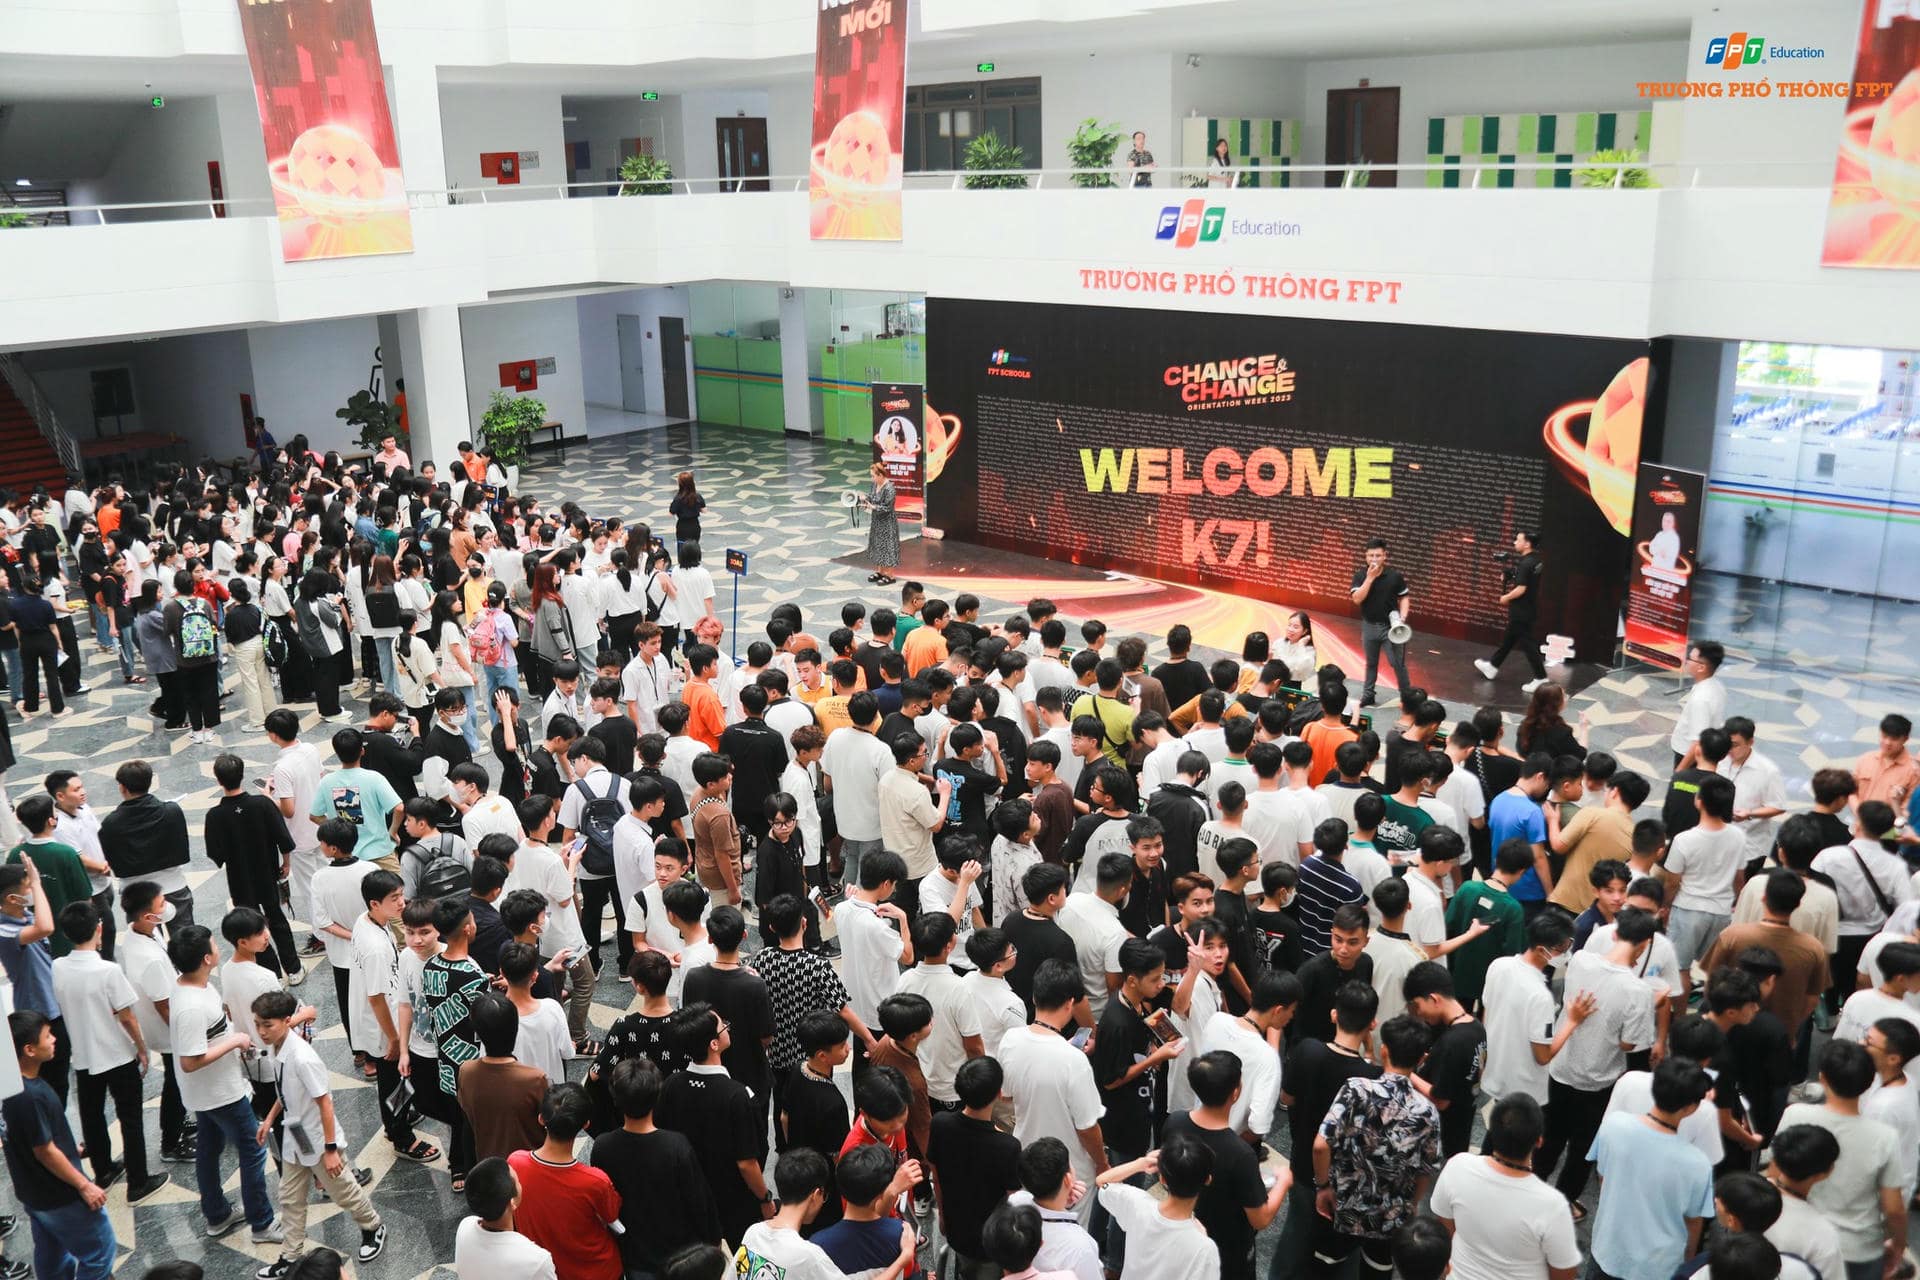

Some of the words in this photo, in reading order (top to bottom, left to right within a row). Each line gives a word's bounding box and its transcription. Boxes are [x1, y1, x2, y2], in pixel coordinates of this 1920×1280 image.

[1232, 219, 1301, 237] Education
[1183, 267, 1236, 297] PHỔ
[1243, 272, 1339, 302] THÔNG
[1346, 280, 1401, 304] FPT
[1163, 353, 1277, 386] CHANCE
[1276, 358, 1288, 375] &
[1181, 371, 1297, 403] CHANGE
[1187, 401, 1241, 411] ORIENTATION
[1244, 397, 1267, 406] WEEK
[1270, 394, 1292, 403] 2023
[1079, 446, 1394, 498] WELCOME
[1181, 518, 1272, 568] K7!
